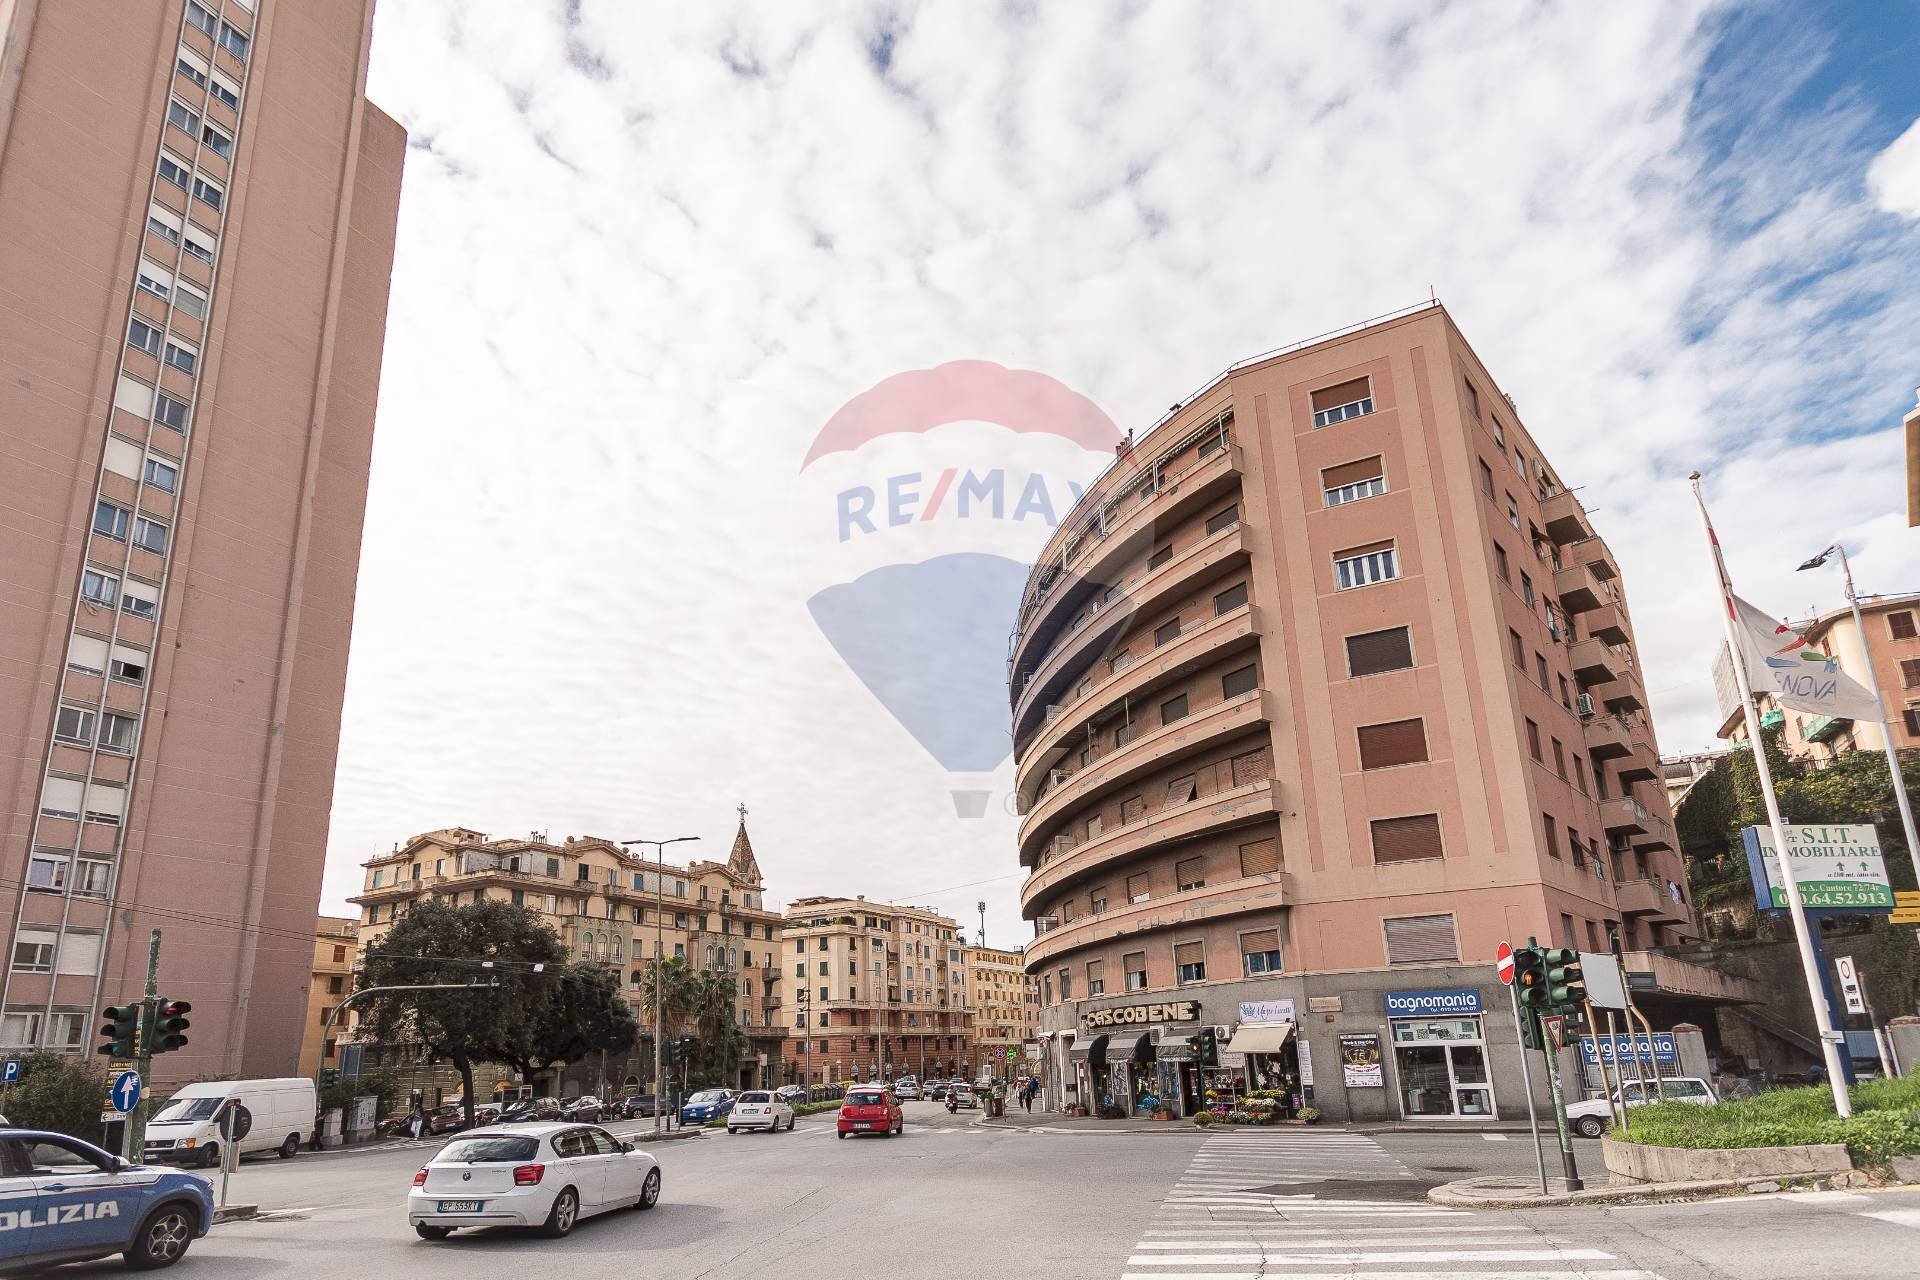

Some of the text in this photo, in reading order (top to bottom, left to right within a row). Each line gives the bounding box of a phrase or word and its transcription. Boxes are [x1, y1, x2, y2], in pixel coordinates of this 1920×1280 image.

[1801, 828, 1857, 844] S.I.T.
[1779, 892, 1887, 905] 00.64.52.913
[1387, 992, 1477, 1012] bagnomania
[1087, 1002, 1193, 1027] CASCOBENE
[1584, 1040, 1672, 1056] bgomaia
[5, 1062, 17, 1079] P
